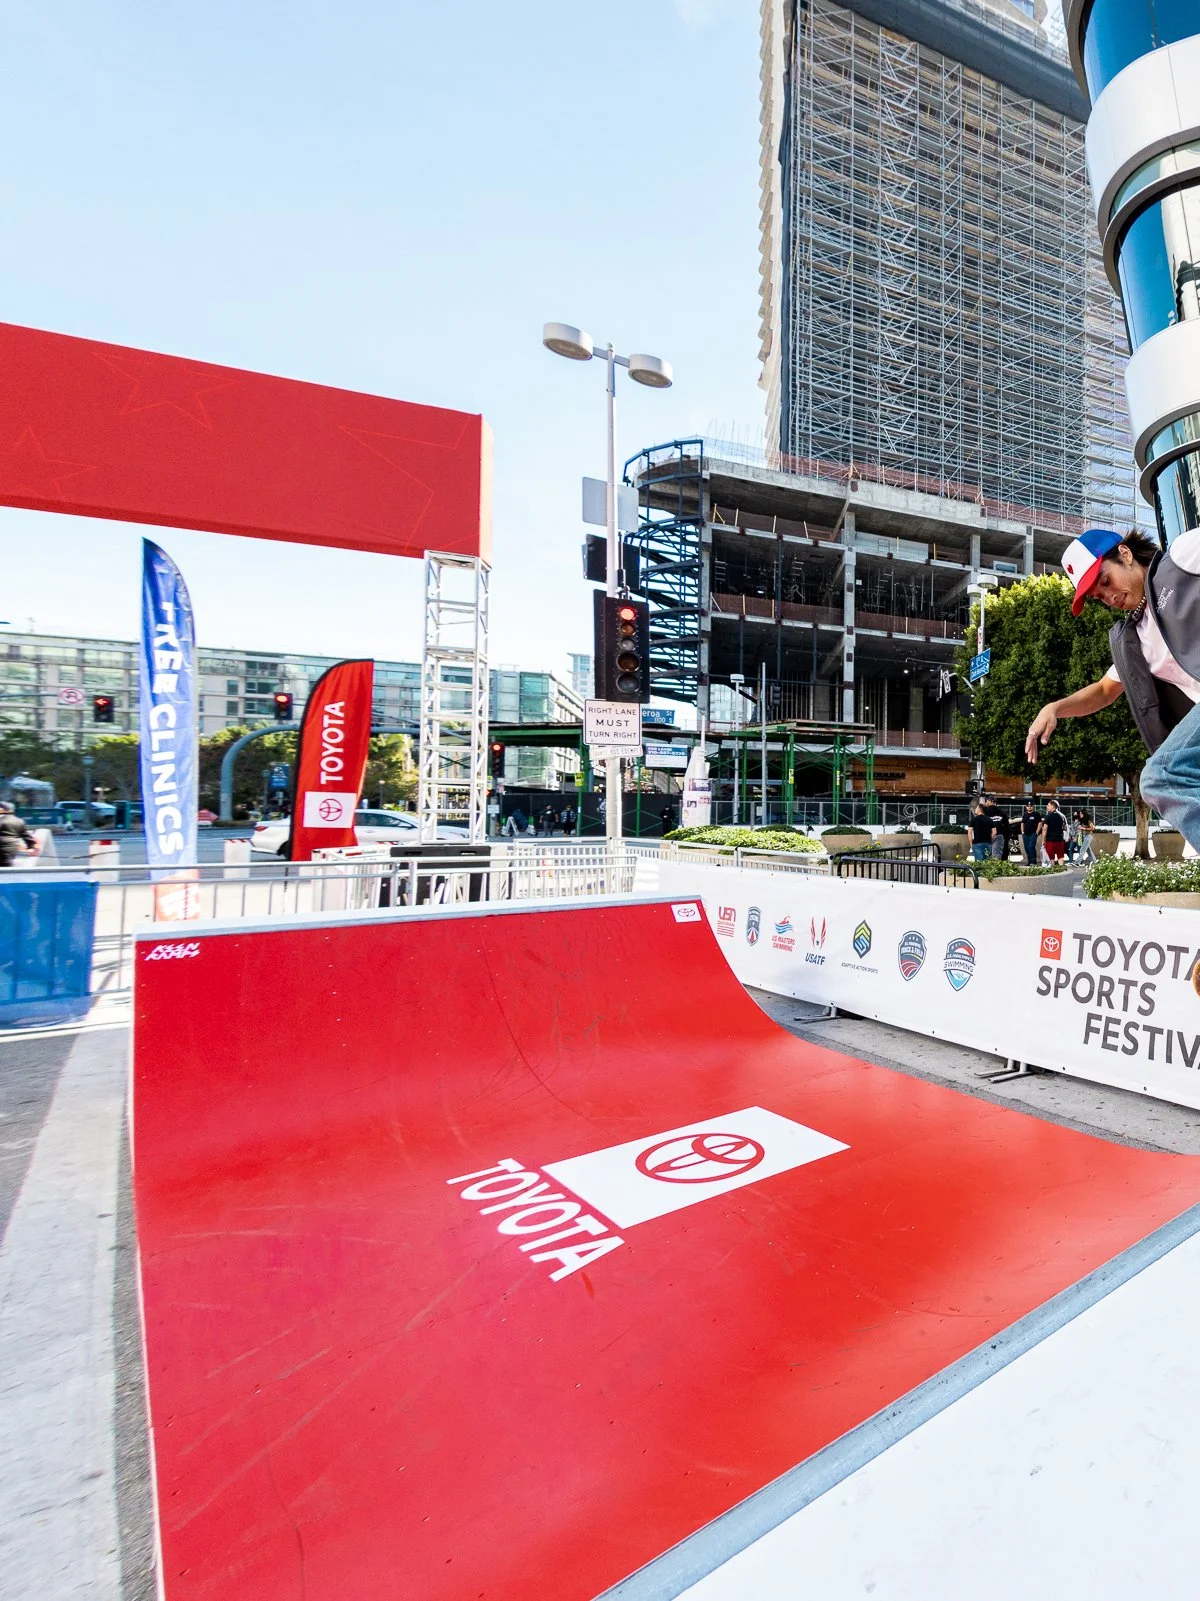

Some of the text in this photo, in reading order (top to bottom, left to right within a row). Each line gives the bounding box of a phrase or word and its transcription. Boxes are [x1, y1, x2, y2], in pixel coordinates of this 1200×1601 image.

[588, 706, 637, 716] RIGHT LANE
[596, 719, 630, 727] MUST
[588, 730, 610, 738] TURN
[320, 700, 345, 785] TOYOTA
[149, 703, 184, 856] CLINICS
[805, 952, 826, 966] USATF
[943, 960, 974, 973] SWIMMING
[1036, 965, 1157, 1016] SPORTS
[447, 1158, 625, 1283] TOYOTA
